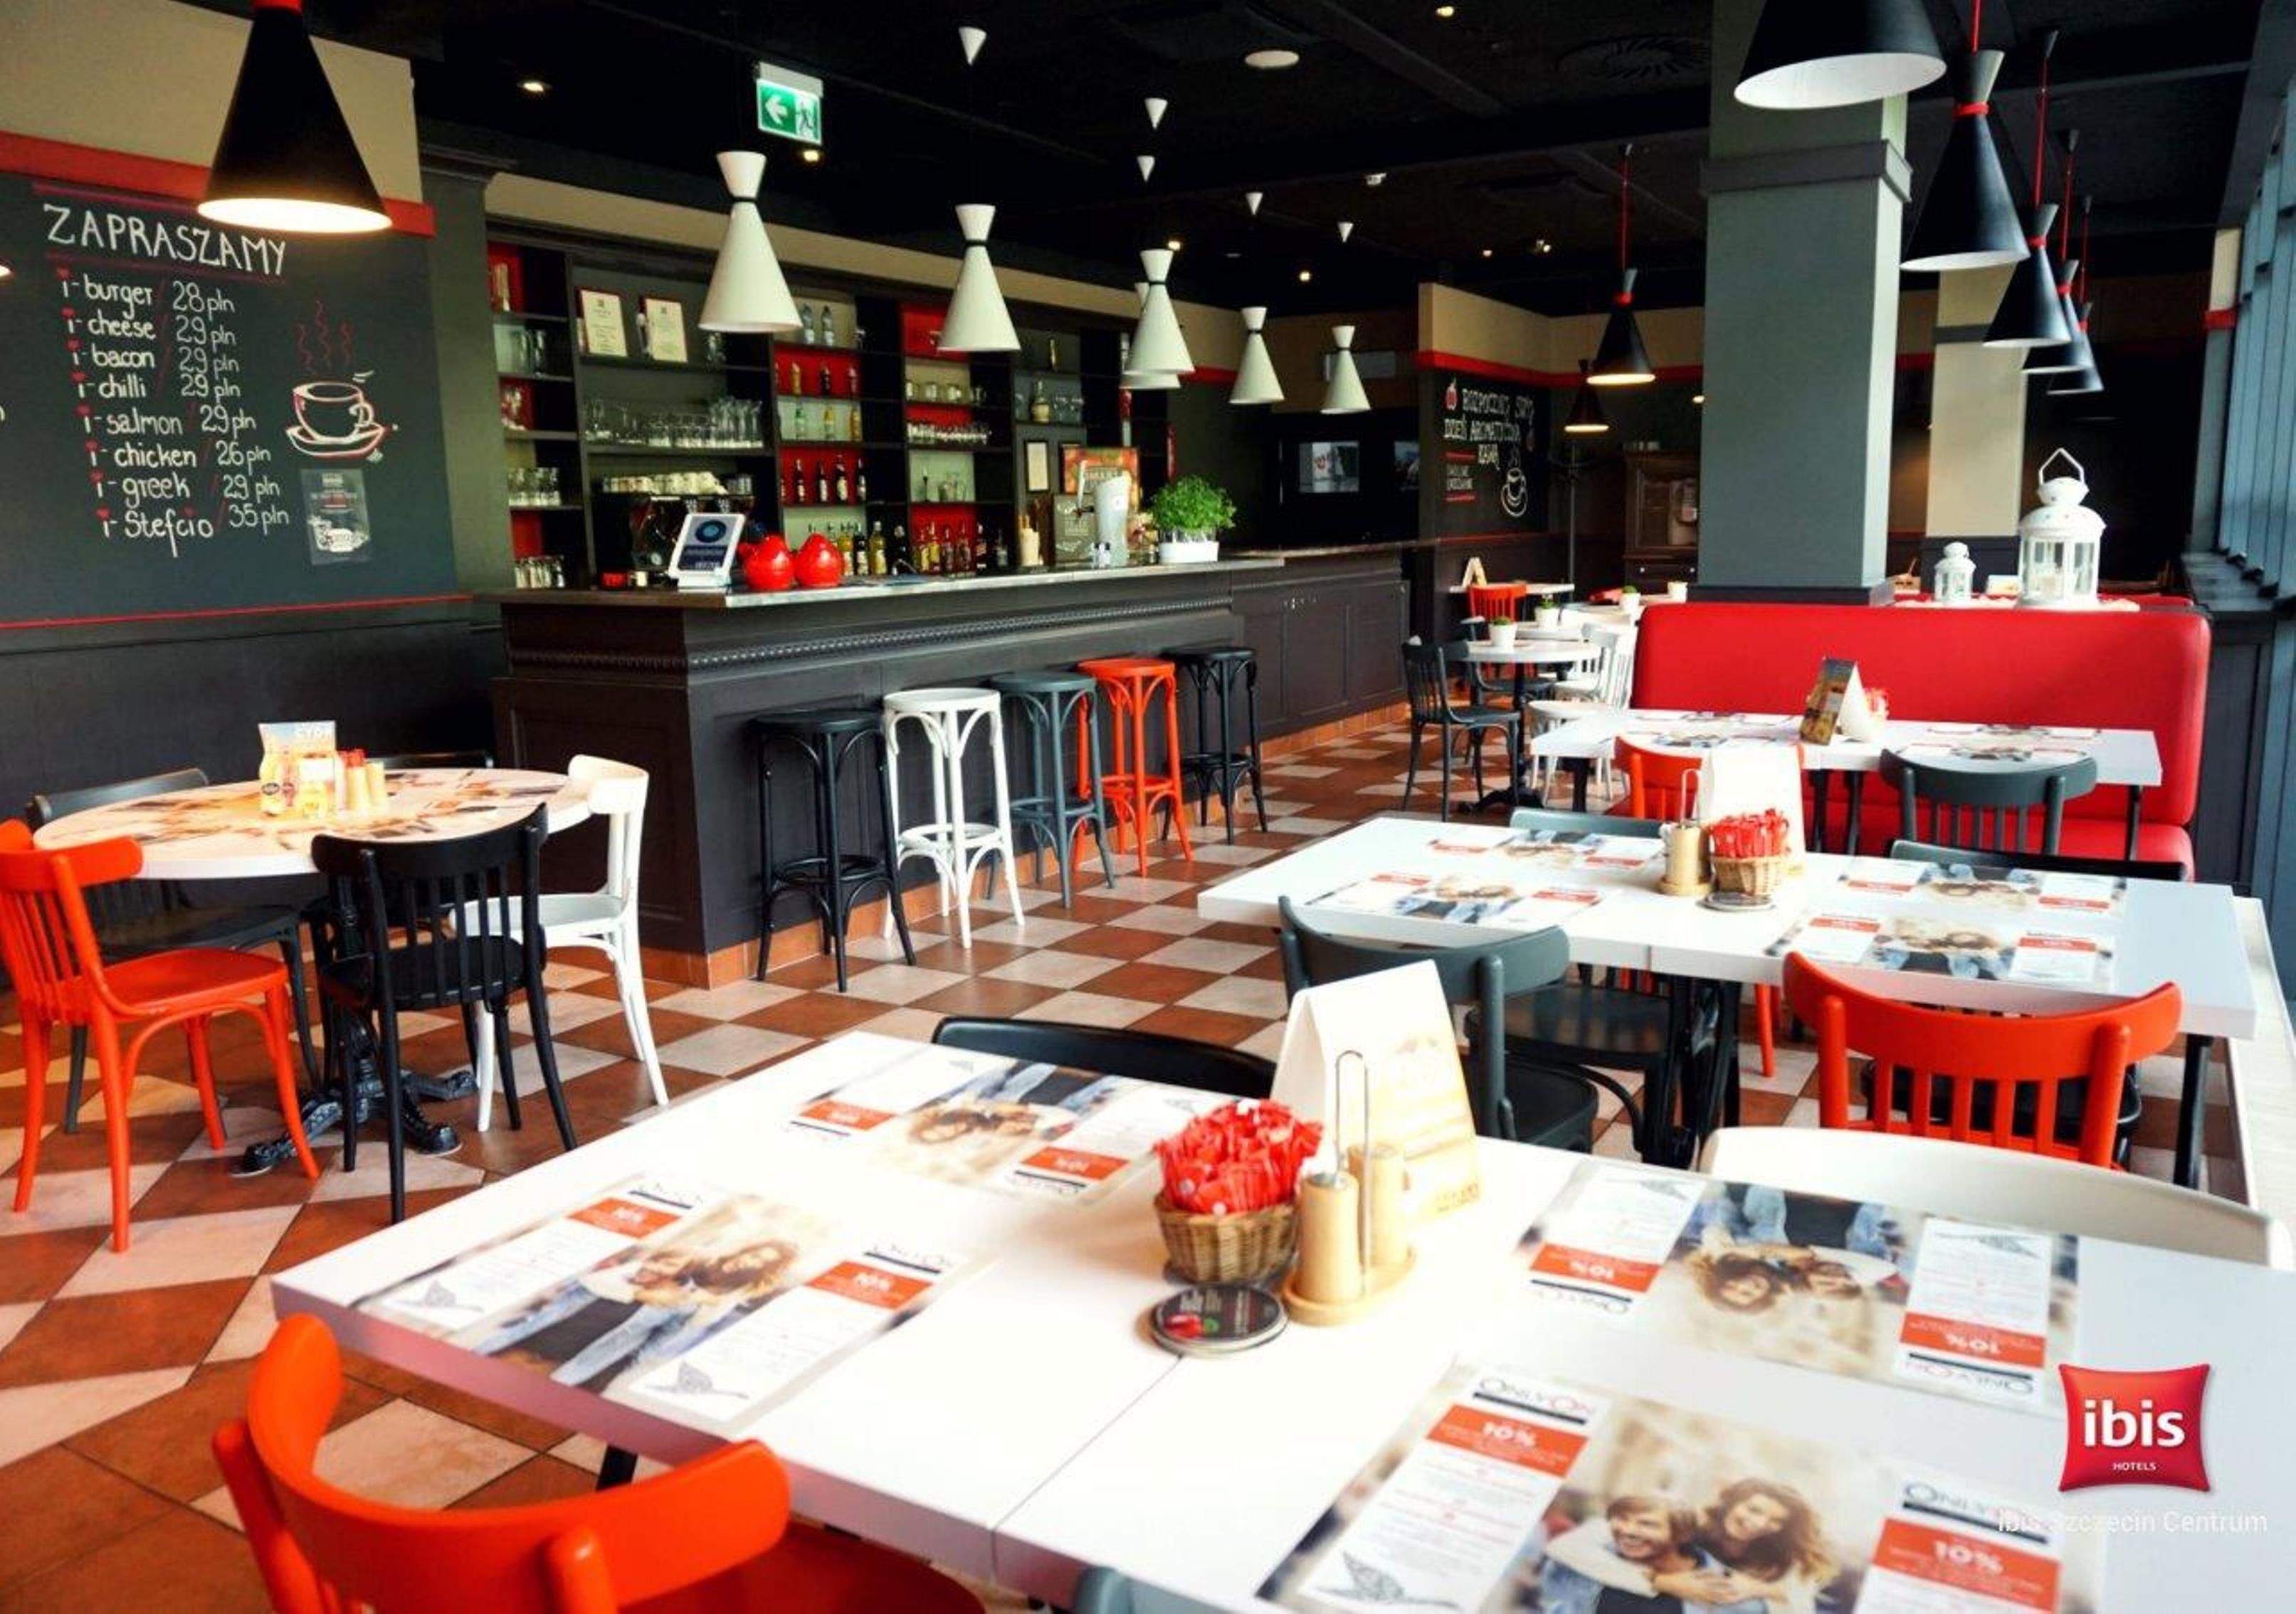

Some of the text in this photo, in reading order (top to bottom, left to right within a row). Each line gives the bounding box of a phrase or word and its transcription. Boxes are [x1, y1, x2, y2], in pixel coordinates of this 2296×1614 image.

[43, 203, 286, 276] ZAPRASZAMY
[1483, 1422, 1537, 1447] 10%
[1933, 1540, 2004, 1574] 10%
